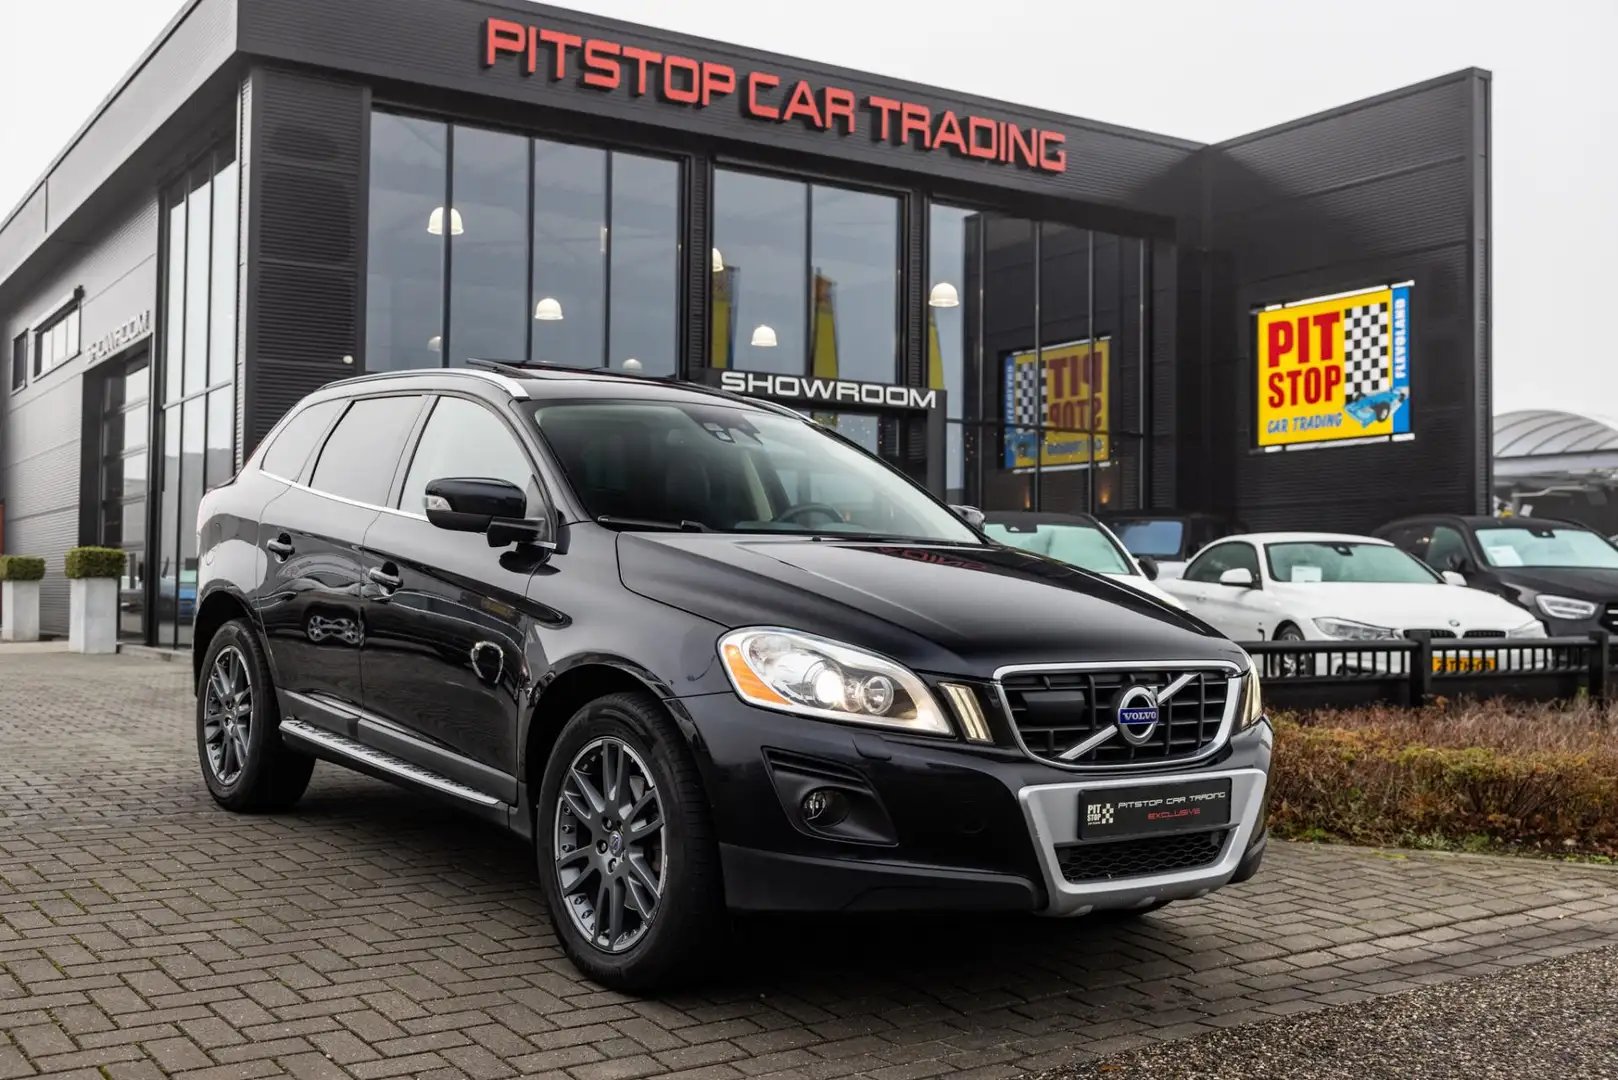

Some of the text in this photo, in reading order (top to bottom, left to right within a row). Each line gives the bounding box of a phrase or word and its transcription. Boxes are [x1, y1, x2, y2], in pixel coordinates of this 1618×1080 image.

[485, 18, 1067, 173] PITSTOP CAR TRADING
[1267, 311, 1341, 369] PIT
[721, 371, 936, 409] SHOWROOM
[1268, 365, 1342, 409] STOP
[1267, 412, 1343, 433] CAR TRADING
[1121, 711, 1157, 721] VOLVO
[1087, 804, 1102, 814] PIT
[1117, 791, 1226, 809] PITSTOP CAR TRADING
[1087, 813, 1102, 822] STOP
[1148, 807, 1201, 820] EXCLUSIVE
